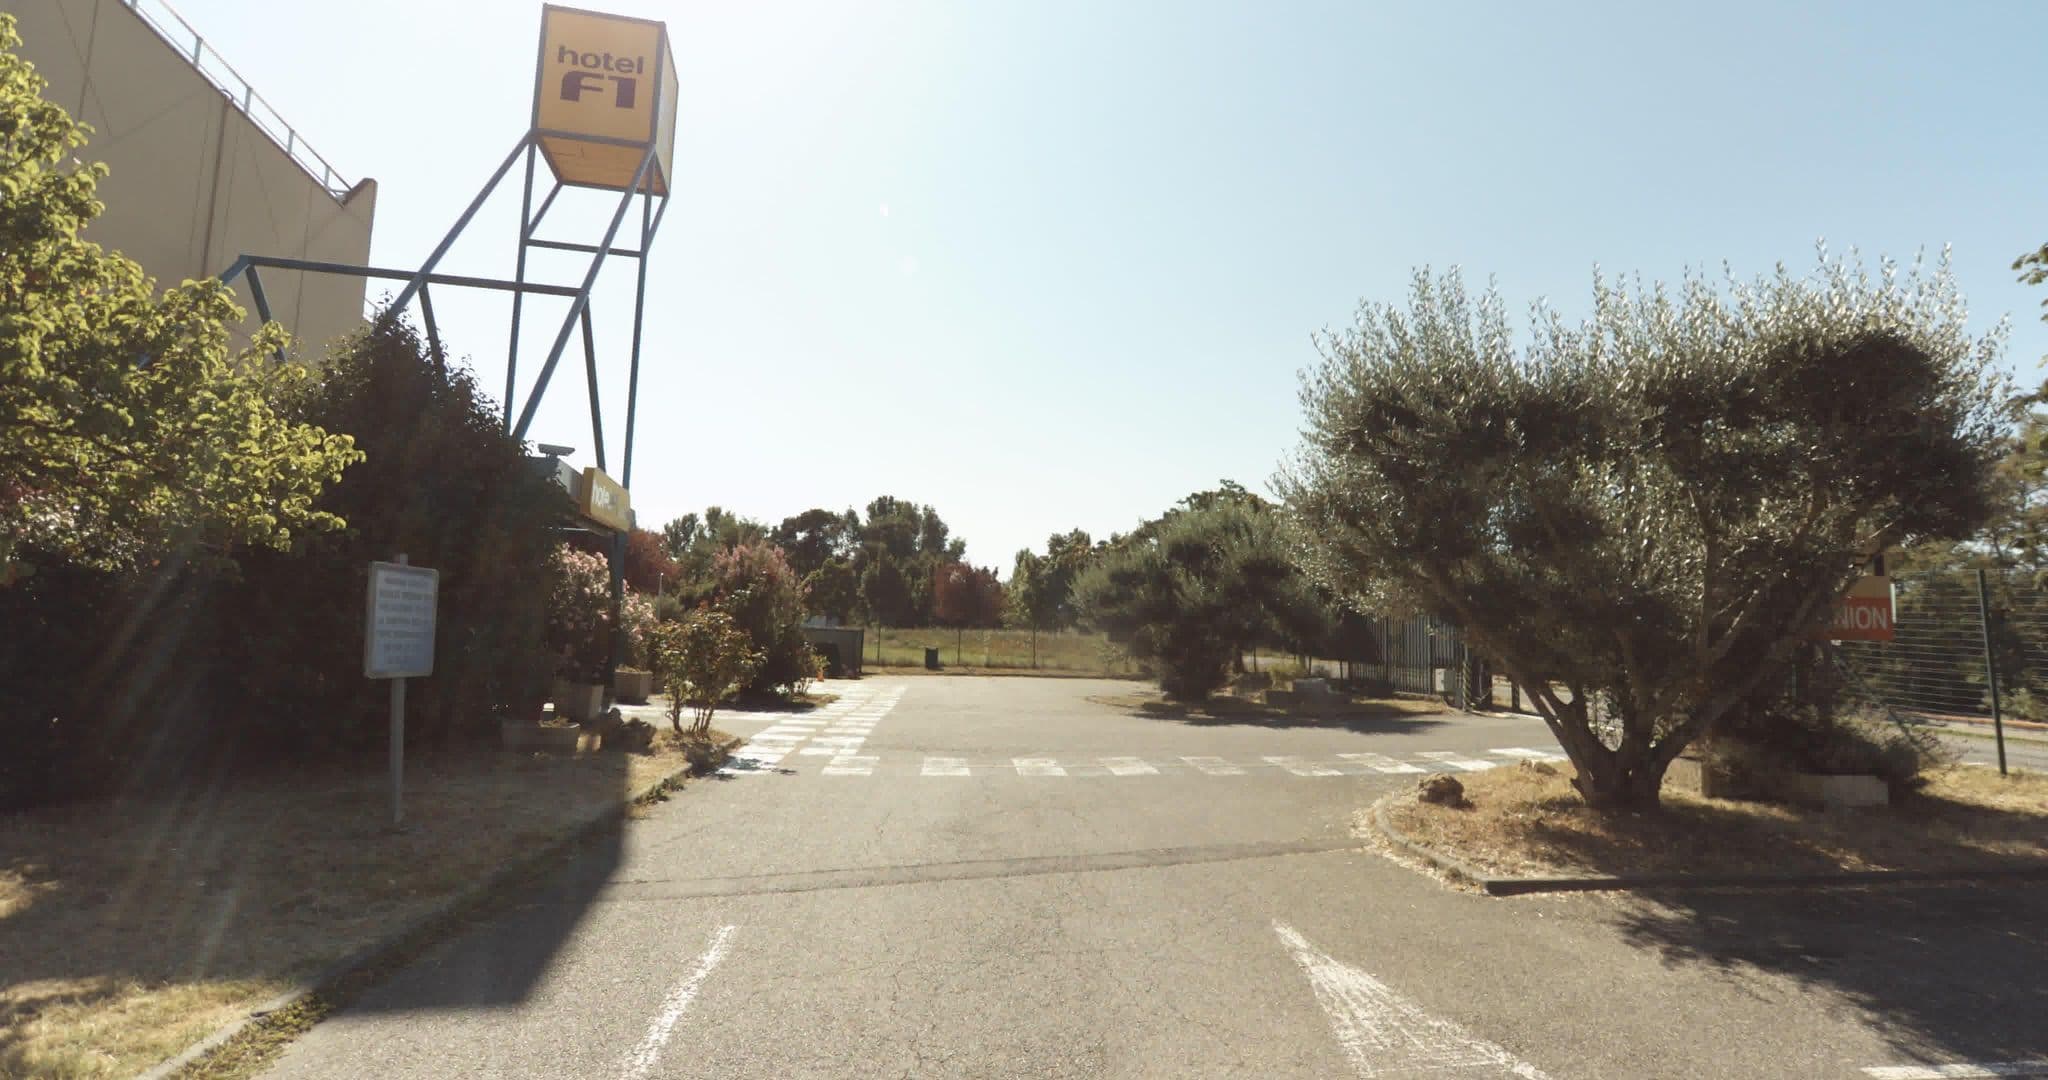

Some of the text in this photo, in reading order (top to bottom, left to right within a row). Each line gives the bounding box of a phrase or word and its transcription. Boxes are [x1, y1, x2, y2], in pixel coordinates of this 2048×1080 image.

[558, 45, 644, 74] hotel
[560, 71, 637, 109] F1
[1832, 605, 1888, 630] NION
